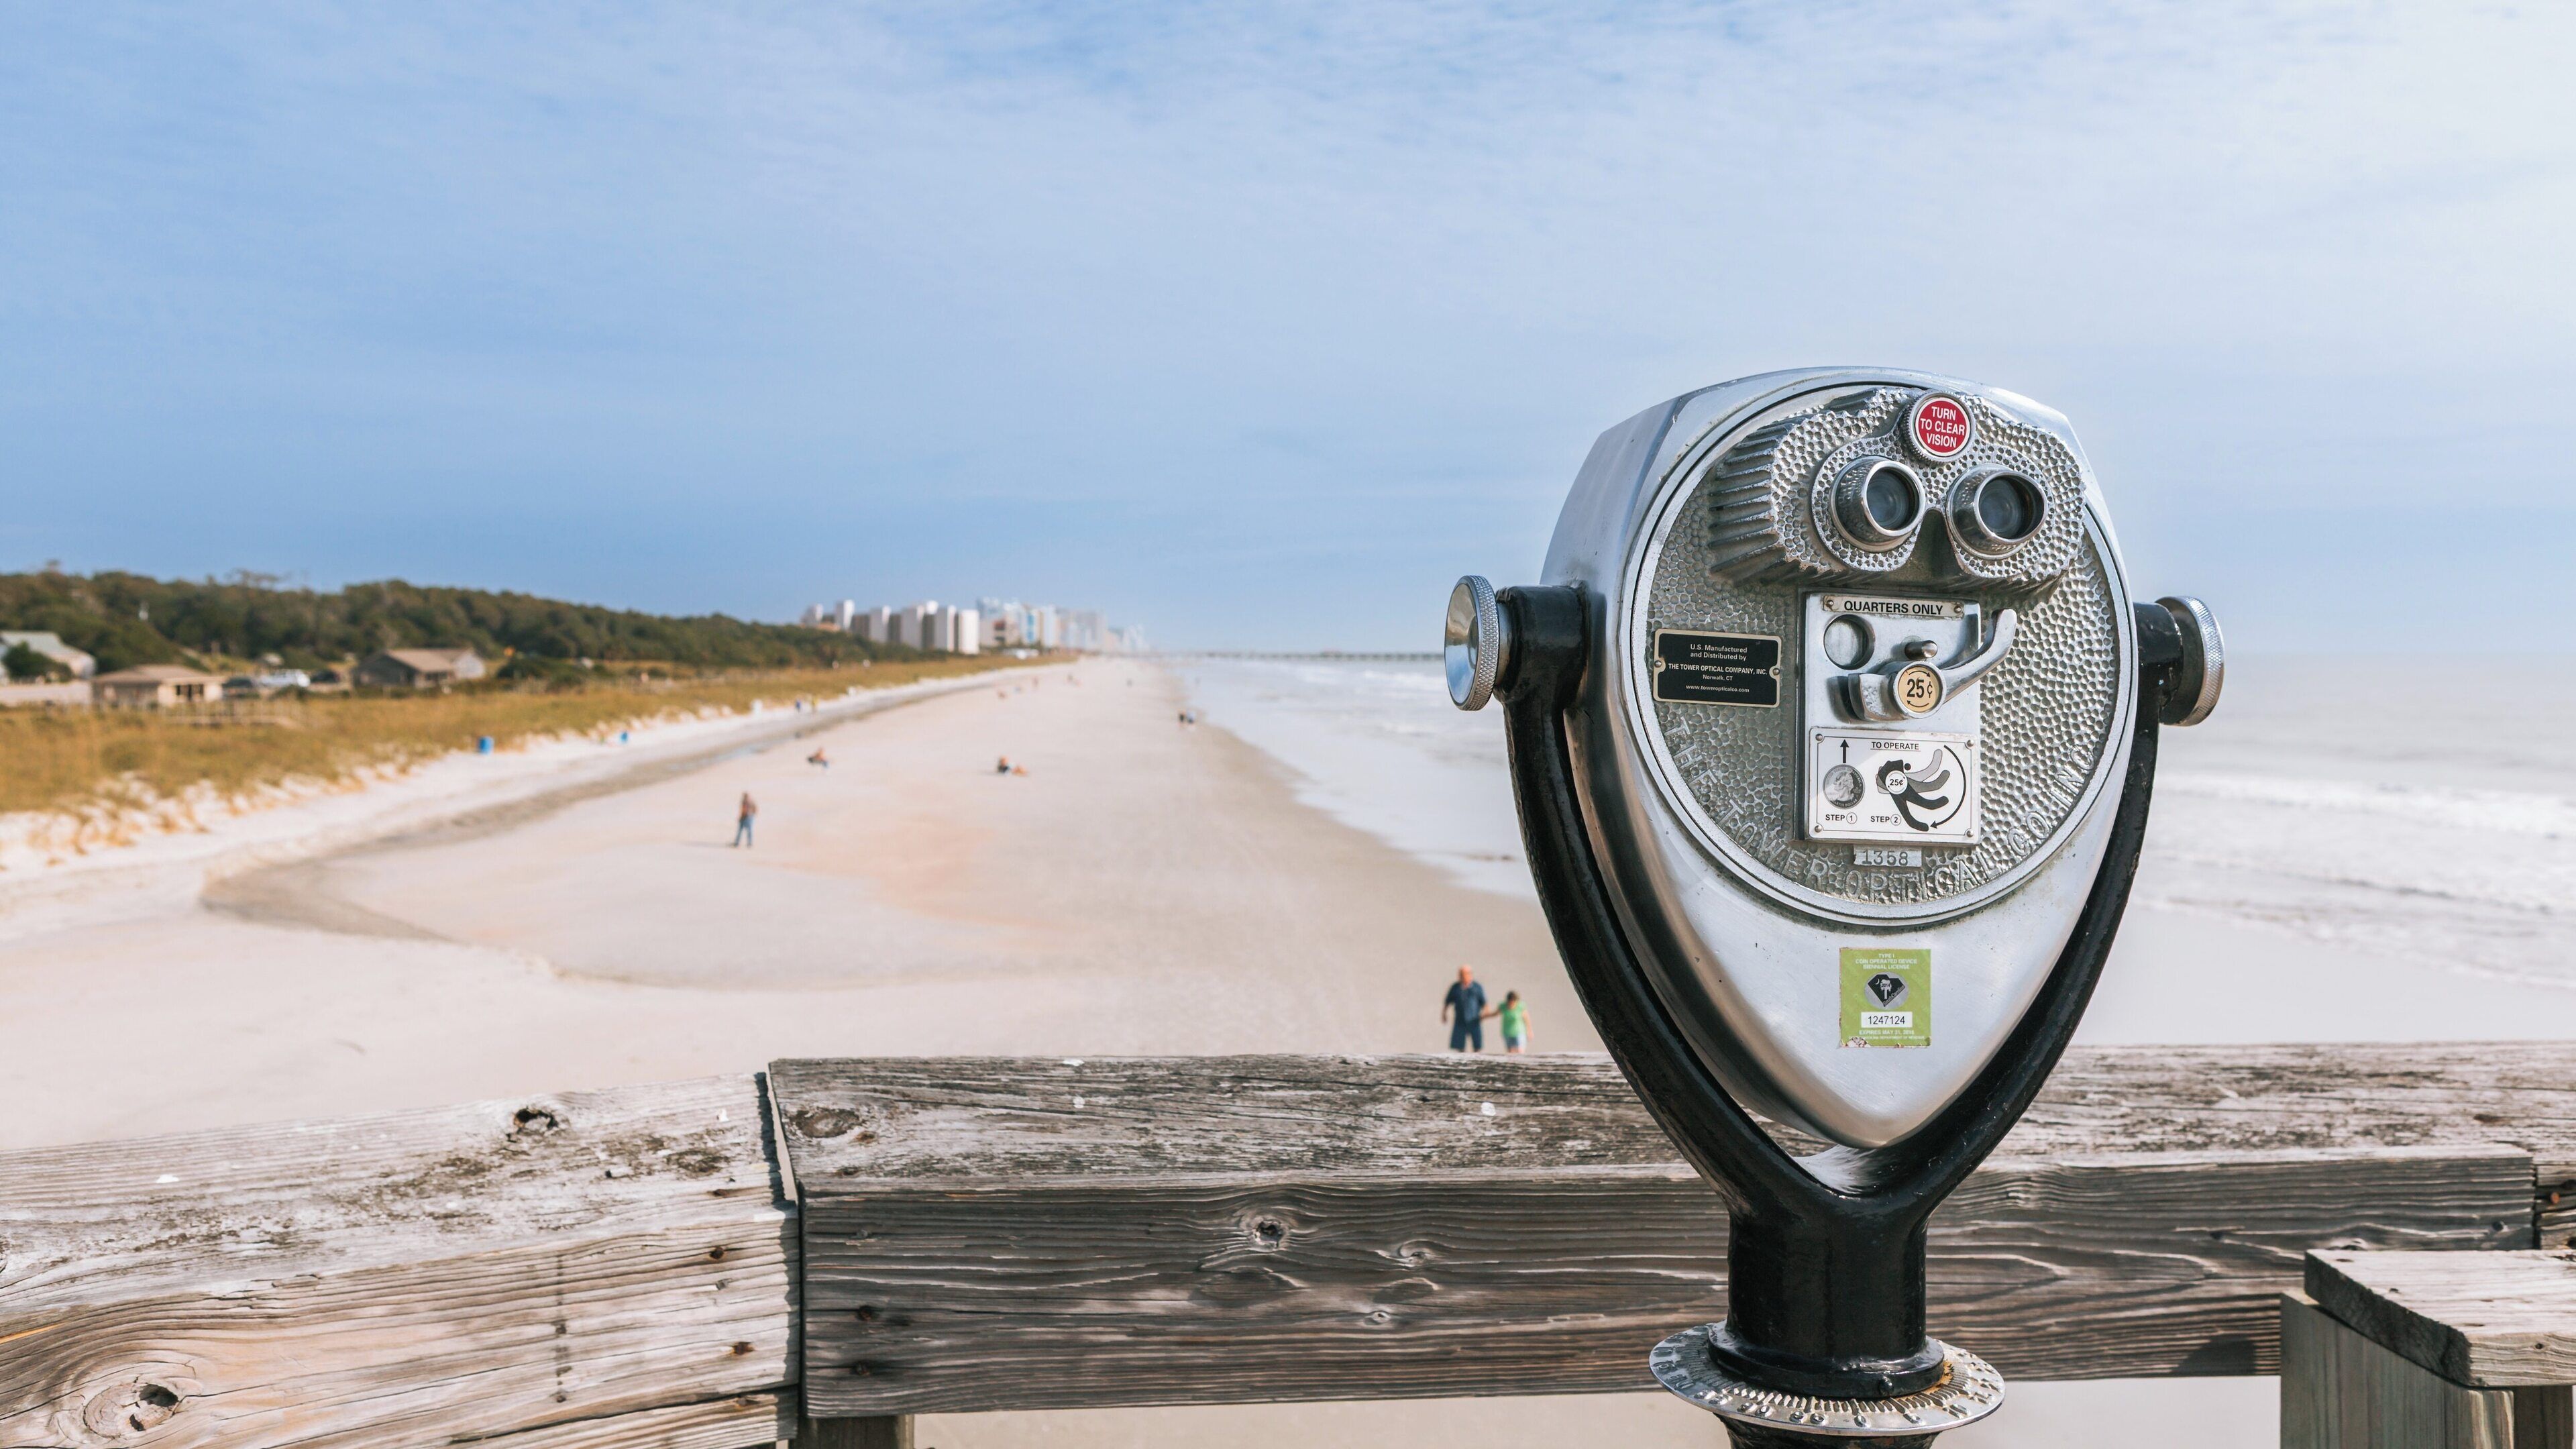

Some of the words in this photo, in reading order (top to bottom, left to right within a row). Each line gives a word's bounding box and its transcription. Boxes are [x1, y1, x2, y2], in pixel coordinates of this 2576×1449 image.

[1931, 406, 1956, 421] TURN
[1920, 418, 1932, 430] TO
[1935, 420, 1965, 436] CLEAR
[1926, 433, 1957, 448] VISION
[1844, 601, 1909, 613] QUARTERS
[1912, 604, 1943, 615] ONLY
[1705, 644, 1747, 653] Manufactured
[1704, 652, 1738, 660] Distributed
[1725, 666, 1755, 675] COMPANY,
[1685, 685, 1750, 693] www.toweropticalco.com
[1907, 678, 1933, 698] 25¢
[1883, 742, 1920, 750] OPERATE
[1889, 778, 1904, 786] 25¢
[1862, 851, 1909, 866] 1358
[1868, 1015, 1906, 1025] 1247124
